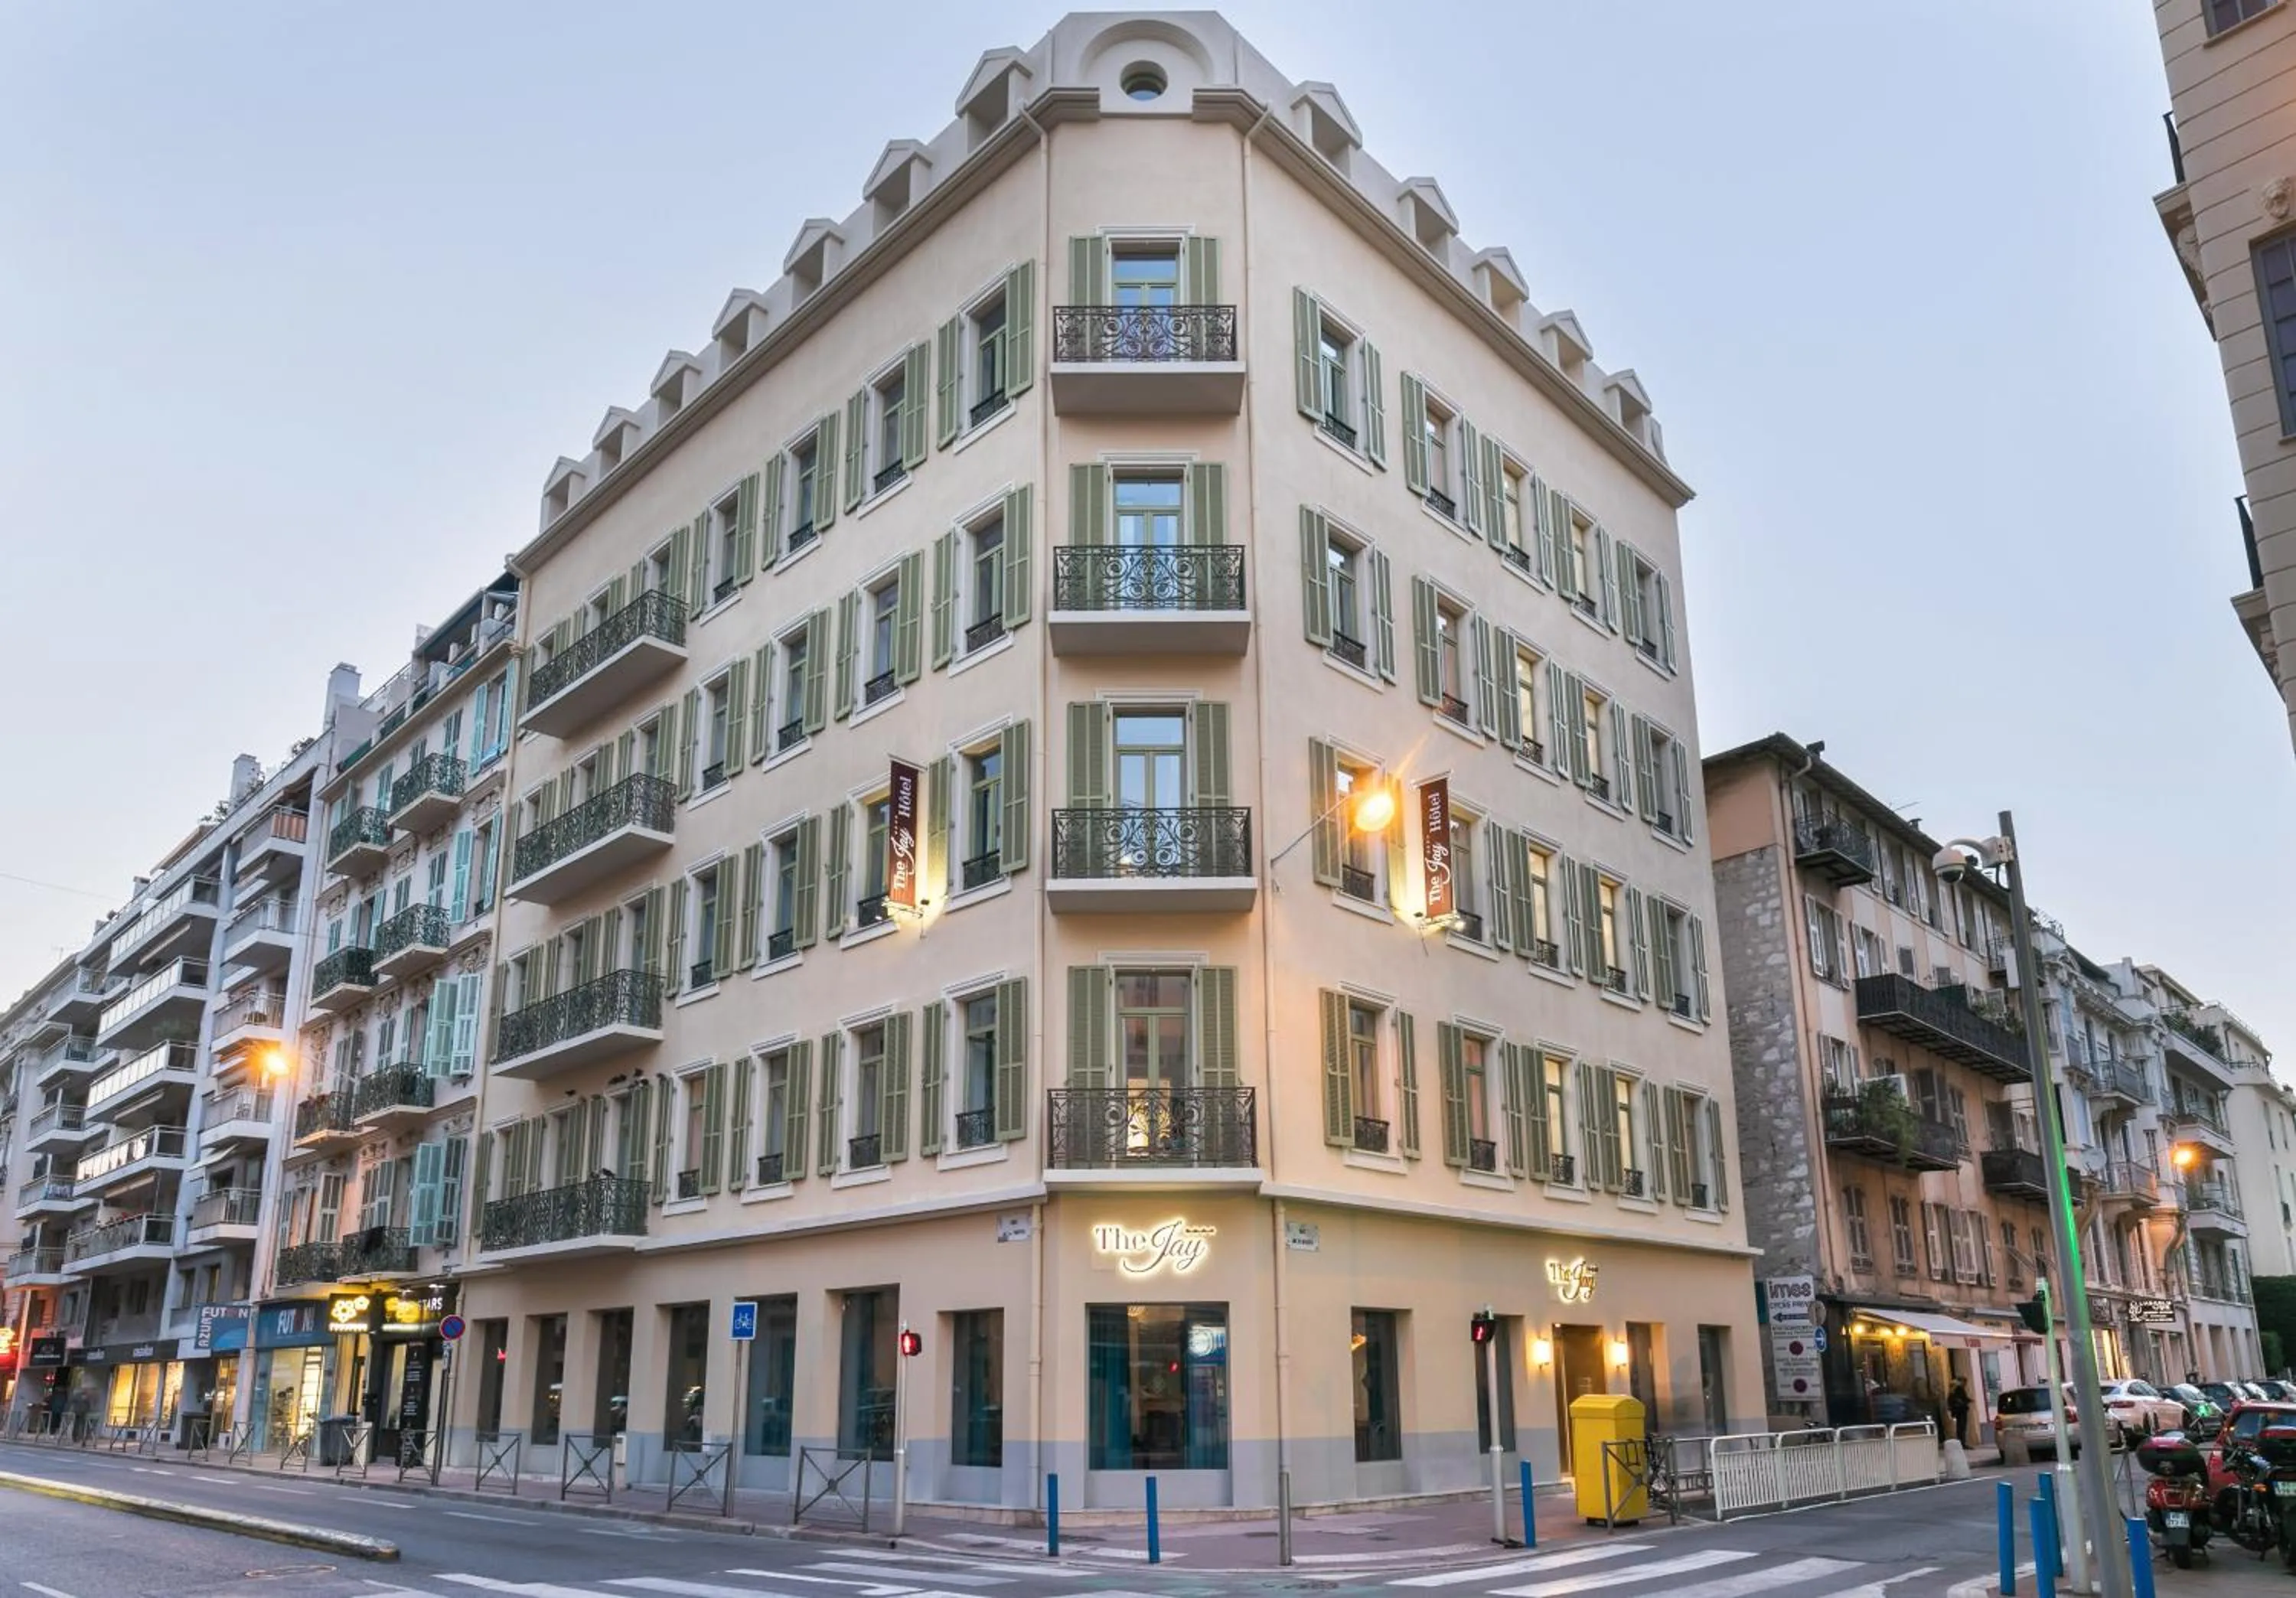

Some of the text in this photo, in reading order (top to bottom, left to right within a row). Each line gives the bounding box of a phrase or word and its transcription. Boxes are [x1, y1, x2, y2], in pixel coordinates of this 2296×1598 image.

[891, 775, 915, 890] The Jay Hôtel
[1425, 791, 1450, 906] The Jay Hôtel
[1095, 1220, 1206, 1273] The Jay
[1549, 1260, 1596, 1300] The Jay
